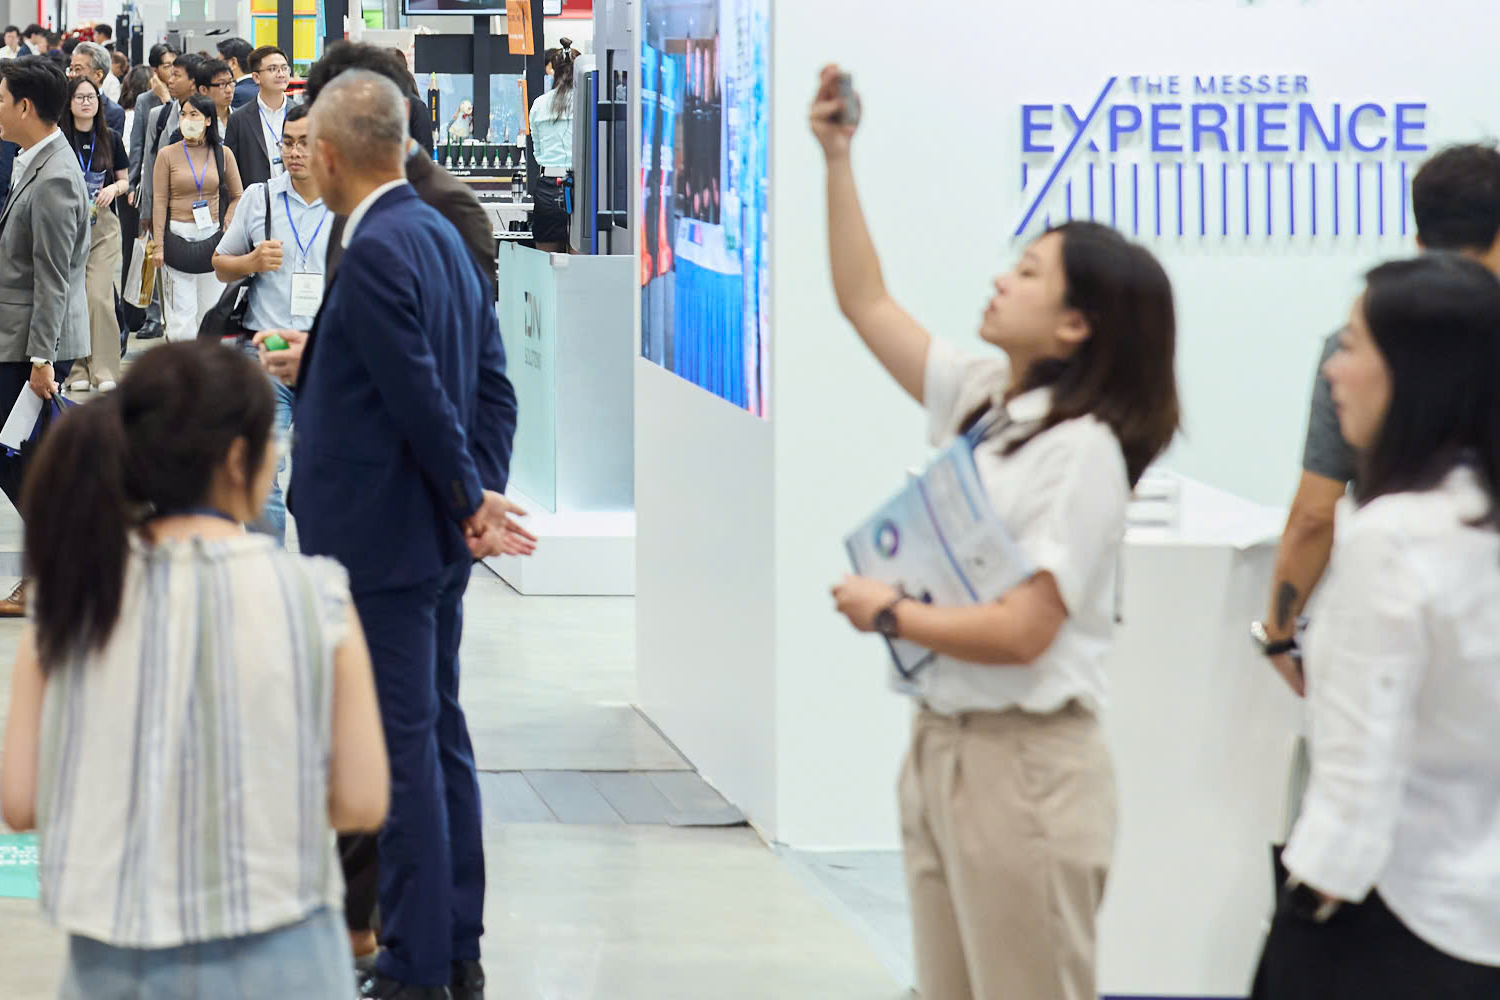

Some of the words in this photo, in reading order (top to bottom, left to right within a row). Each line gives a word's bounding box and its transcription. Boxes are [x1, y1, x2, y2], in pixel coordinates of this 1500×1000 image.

[1130, 75, 1181, 94] THE
[1194, 75, 1310, 94] MESSER
[1022, 103, 1428, 153] EXPERIENCE
